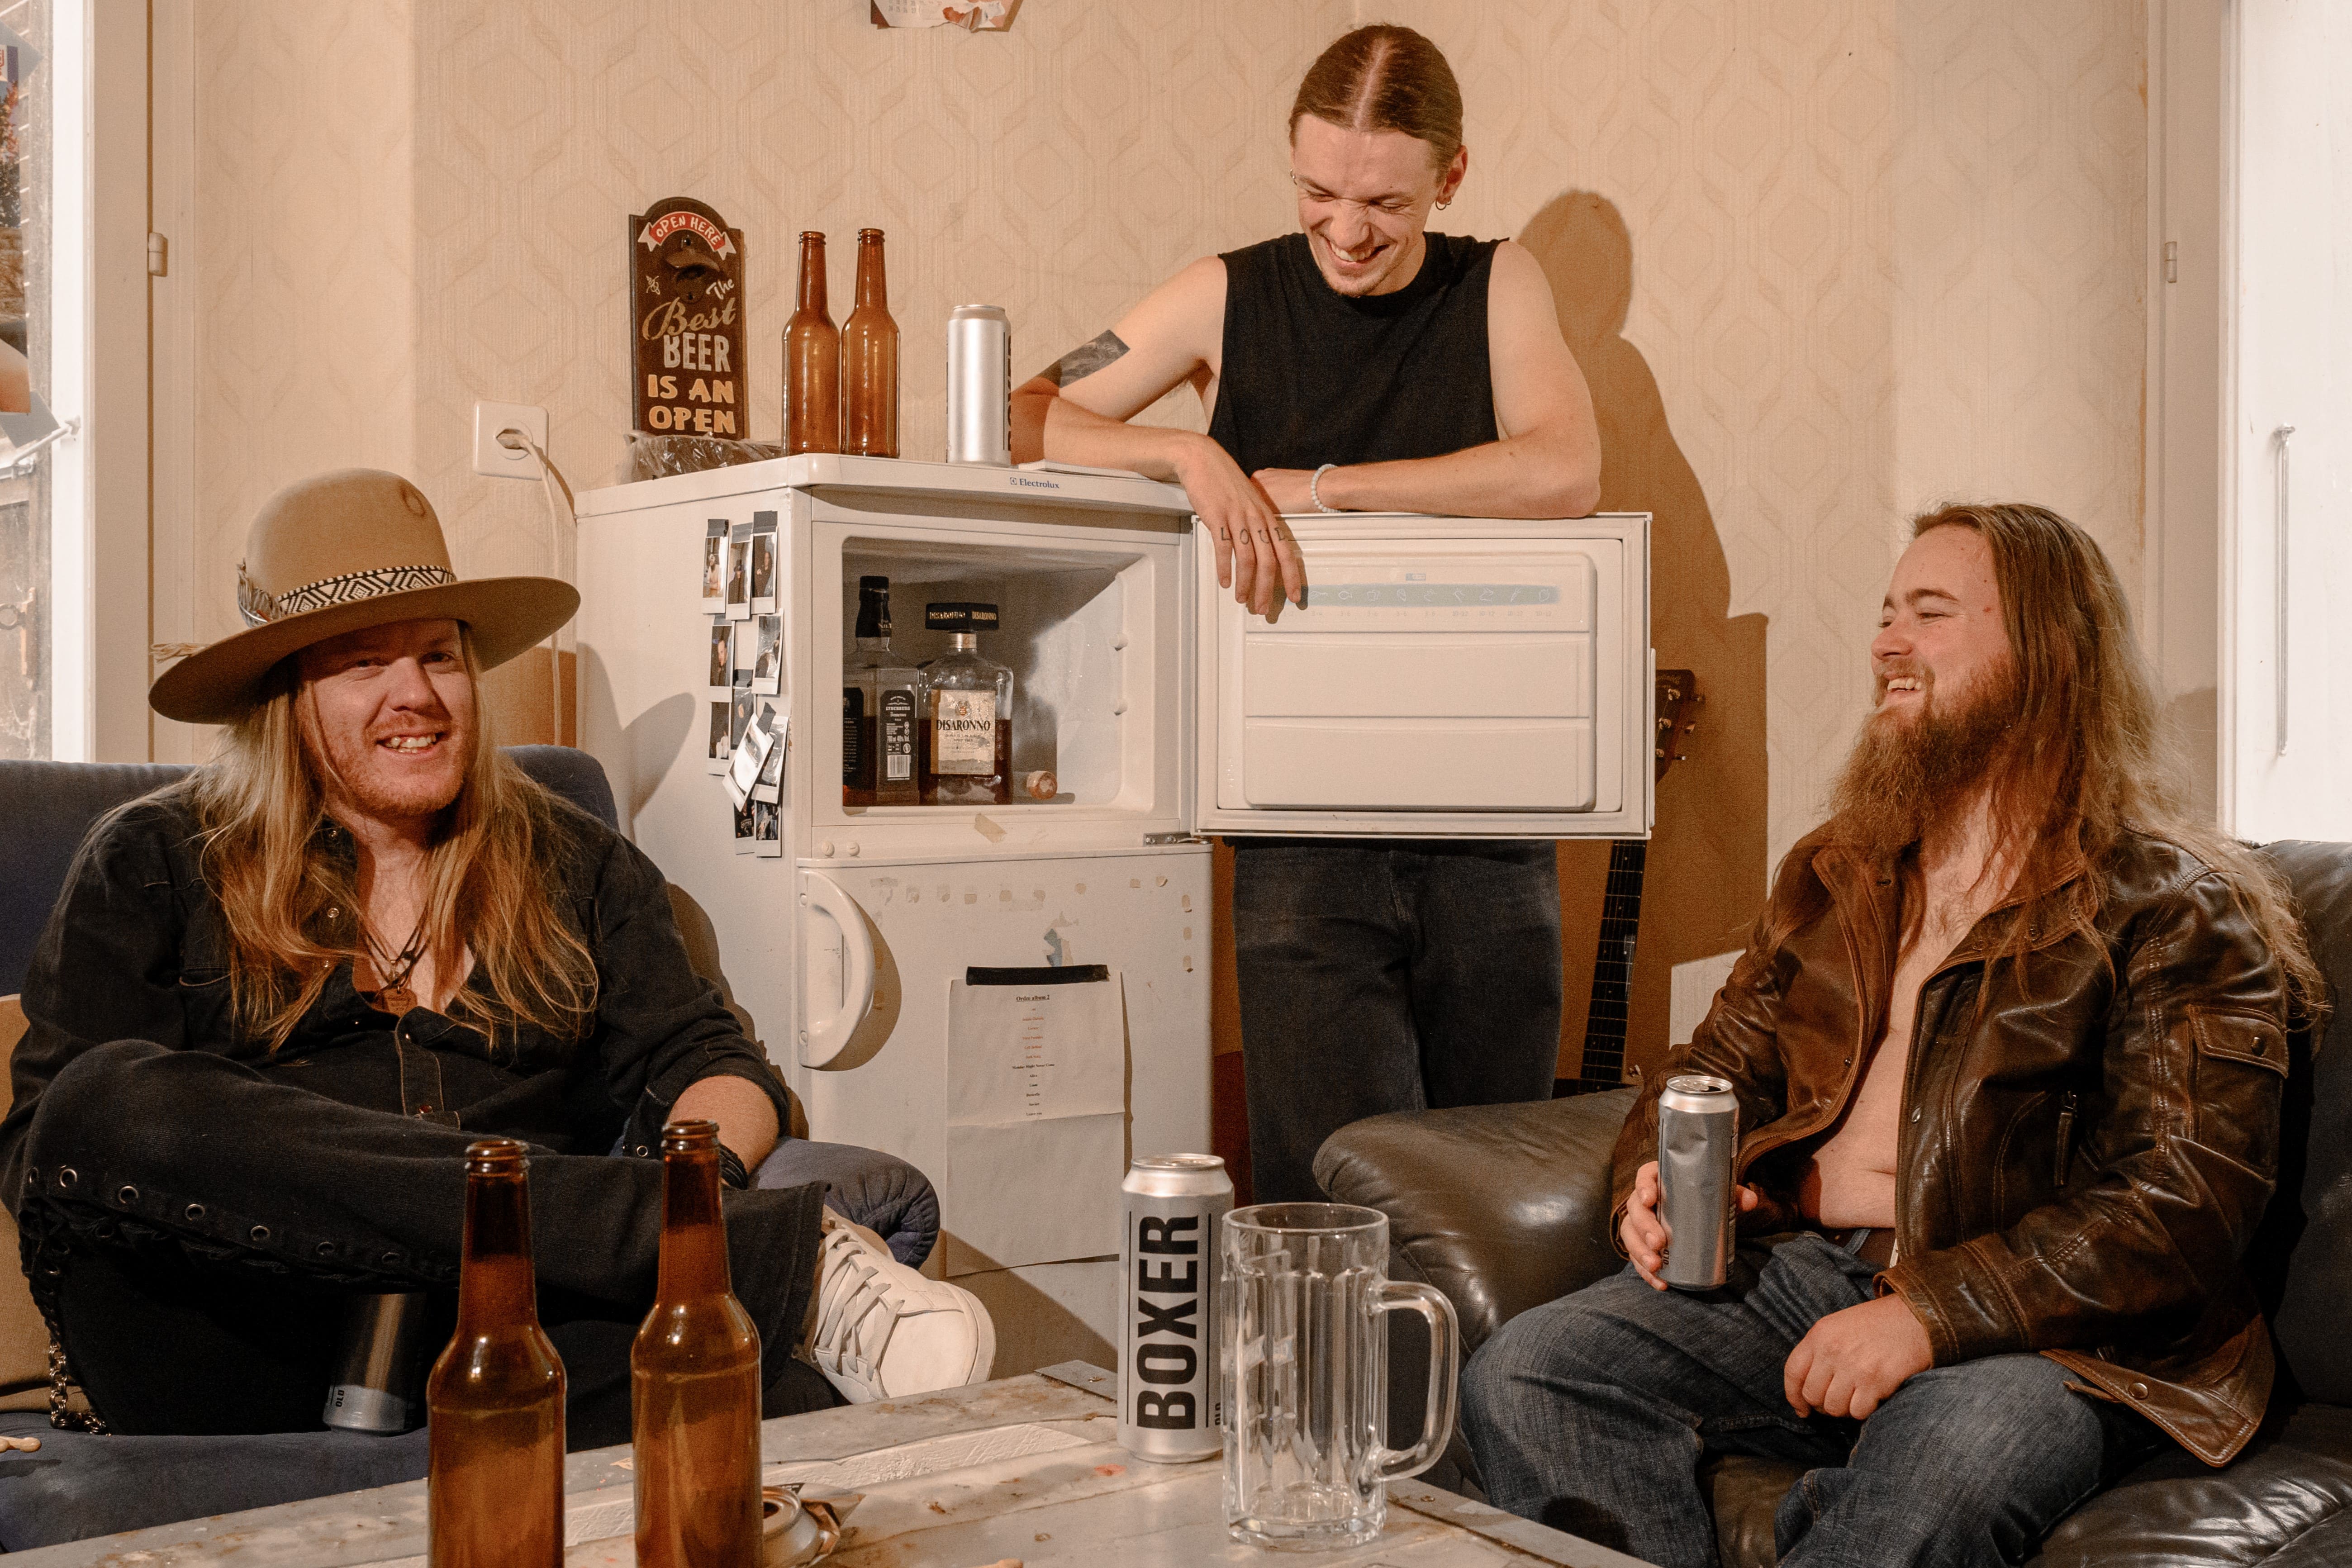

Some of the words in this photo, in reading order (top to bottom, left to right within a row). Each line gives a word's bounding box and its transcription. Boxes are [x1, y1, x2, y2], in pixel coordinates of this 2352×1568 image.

[656, 215, 686, 238] OPEN
[690, 217, 721, 245] HERE
[706, 279, 735, 300] The
[642, 297, 736, 341] Best
[663, 332, 731, 372] BEER
[648, 374, 678, 399] IS
[689, 378, 735, 404] AN
[649, 405, 736, 434] OPEN
[1019, 478, 1060, 489] Electrolux
[936, 719, 991, 732] DISARONNO
[1136, 1215, 1199, 1430] BOXER
[336, 1389, 345, 1407] OLD
